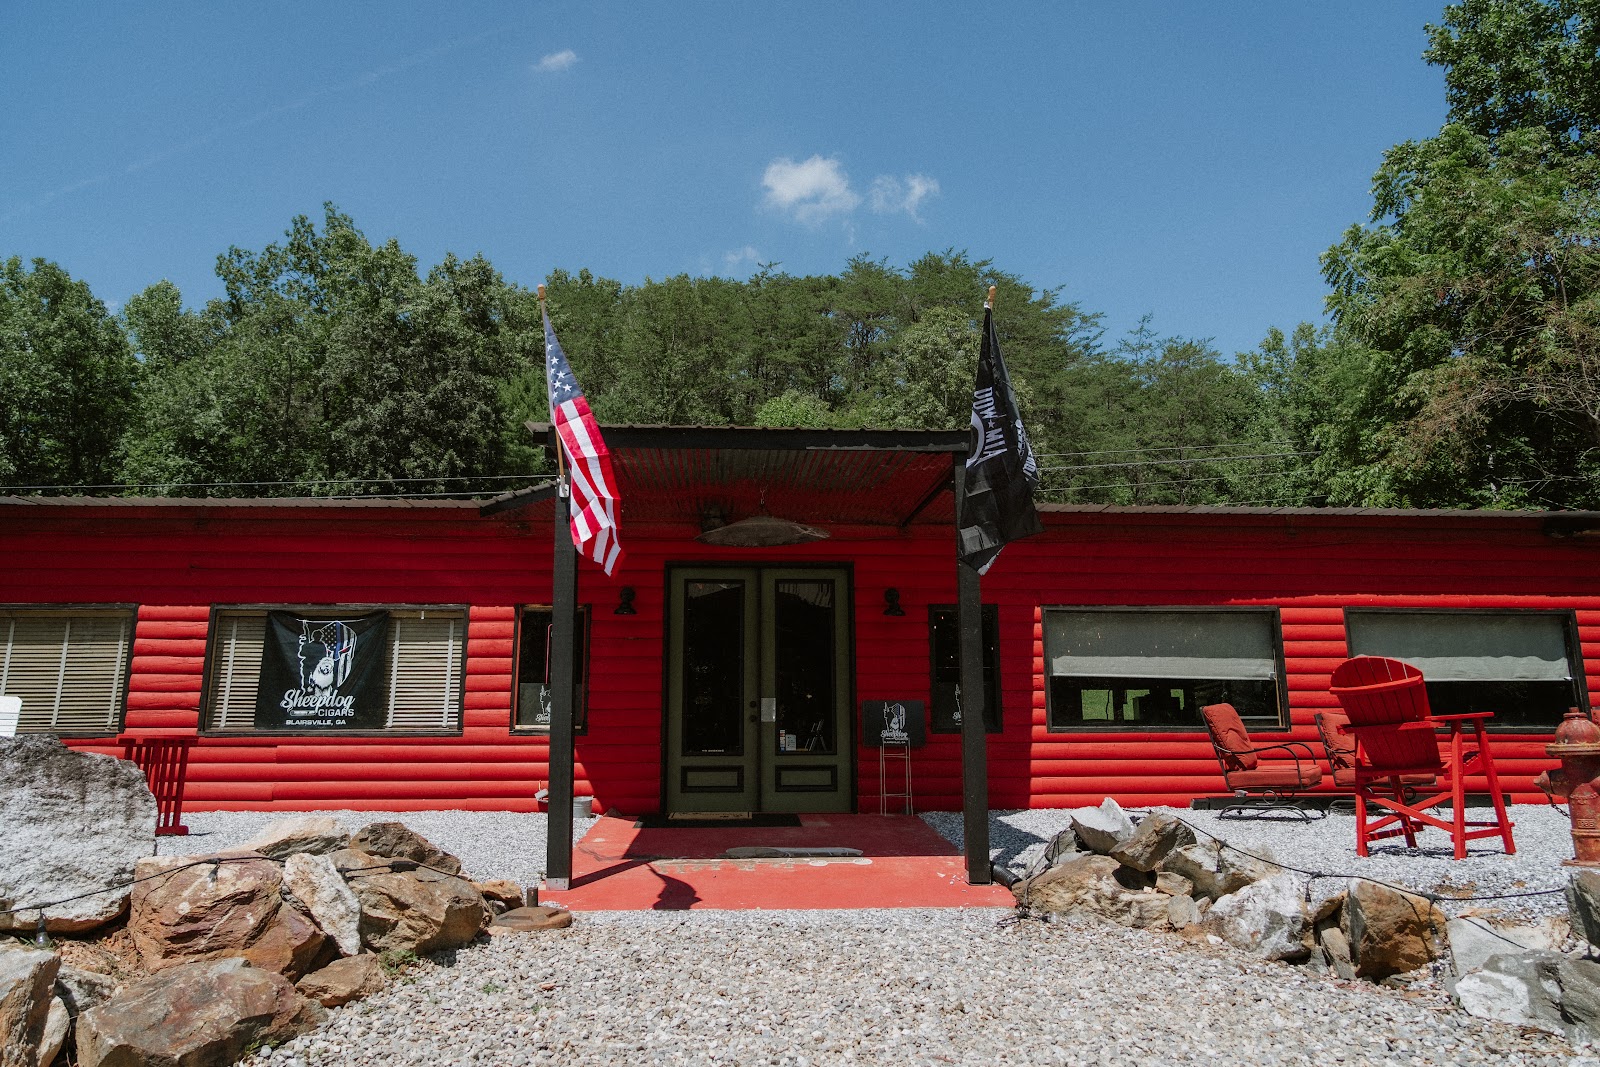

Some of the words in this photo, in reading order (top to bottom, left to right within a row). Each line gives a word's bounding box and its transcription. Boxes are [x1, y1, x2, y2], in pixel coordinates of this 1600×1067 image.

[974, 428, 1008, 467] MIA
[280, 688, 355, 713] Sheepdog
[318, 708, 355, 717] CIGARS
